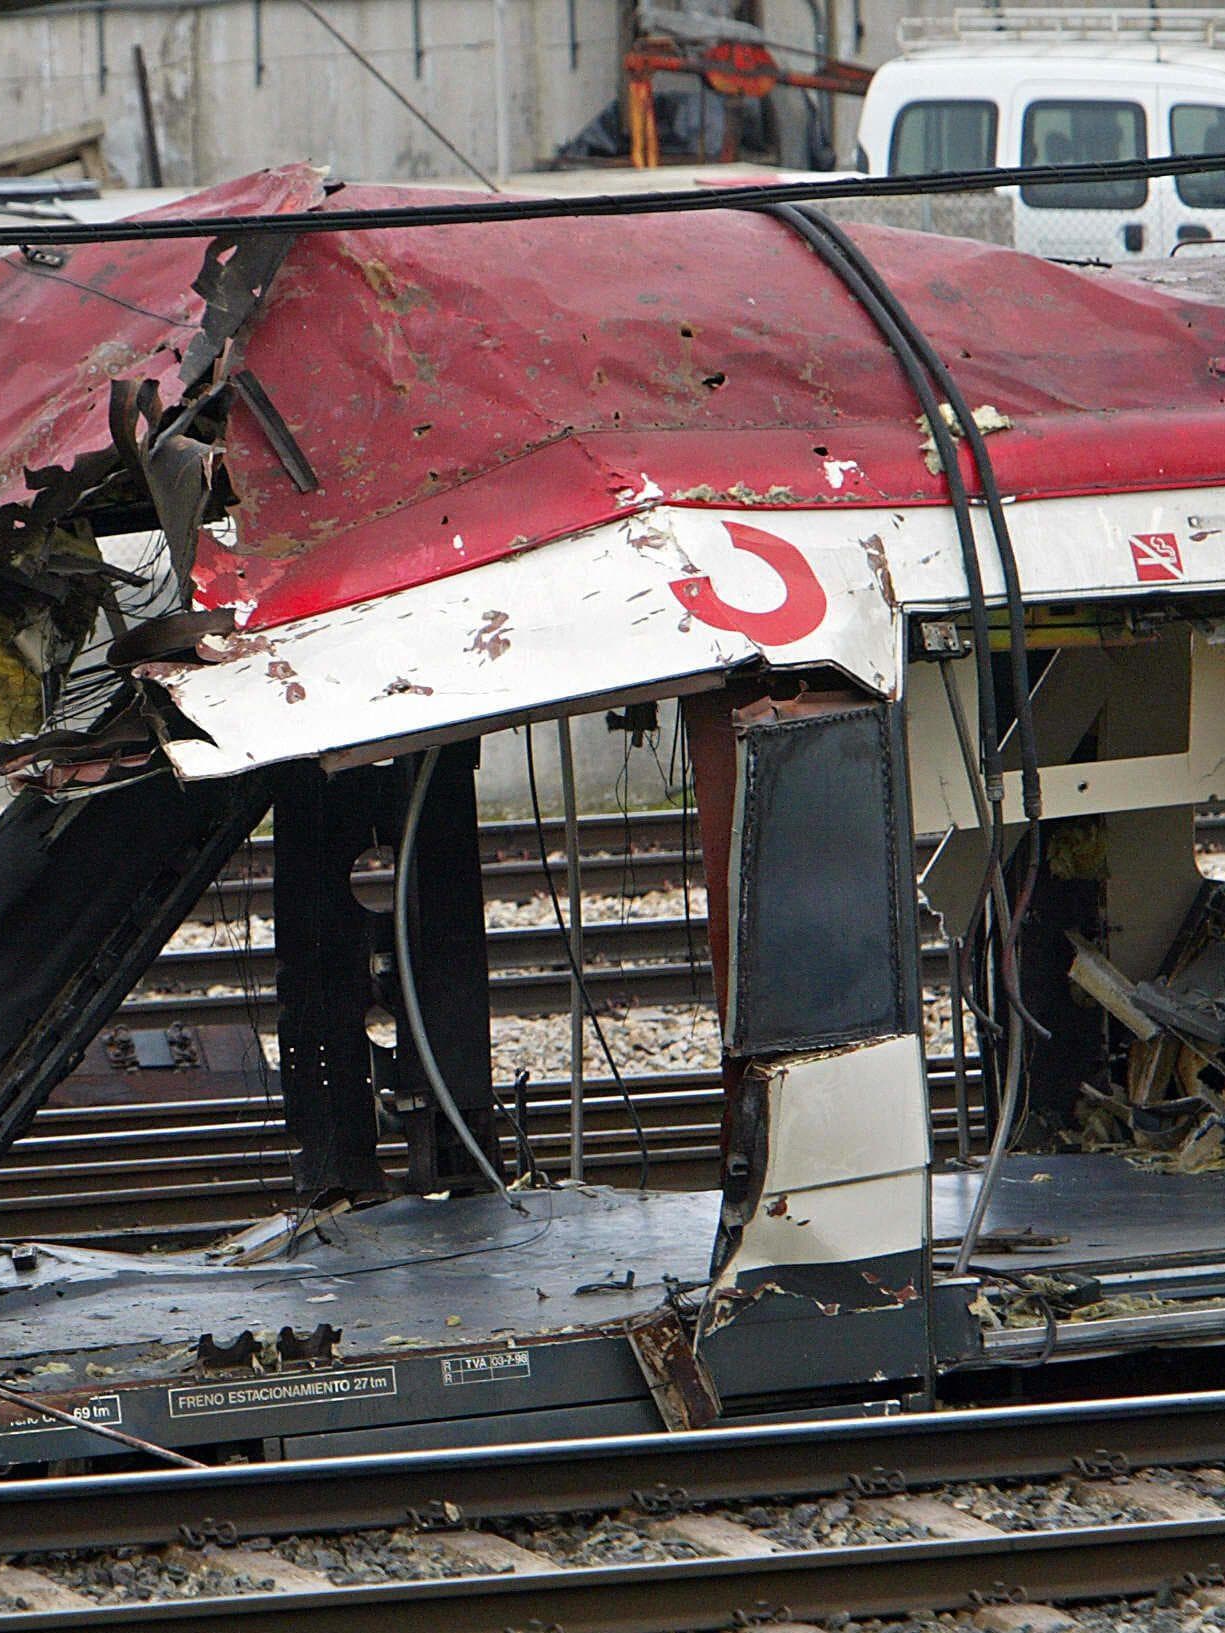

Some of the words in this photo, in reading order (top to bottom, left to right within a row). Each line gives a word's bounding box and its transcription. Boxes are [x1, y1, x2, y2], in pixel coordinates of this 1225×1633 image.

[465, 1357, 487, 1369] TVA
[178, 1393, 224, 1409] FRENO
[228, 1379, 351, 1404] ESTACIONAMIENTO
[353, 1377, 368, 1391] 27
[370, 1376, 388, 1389] tm
[73, 1406, 90, 1420] 69
[92, 1405, 110, 1417] tm
